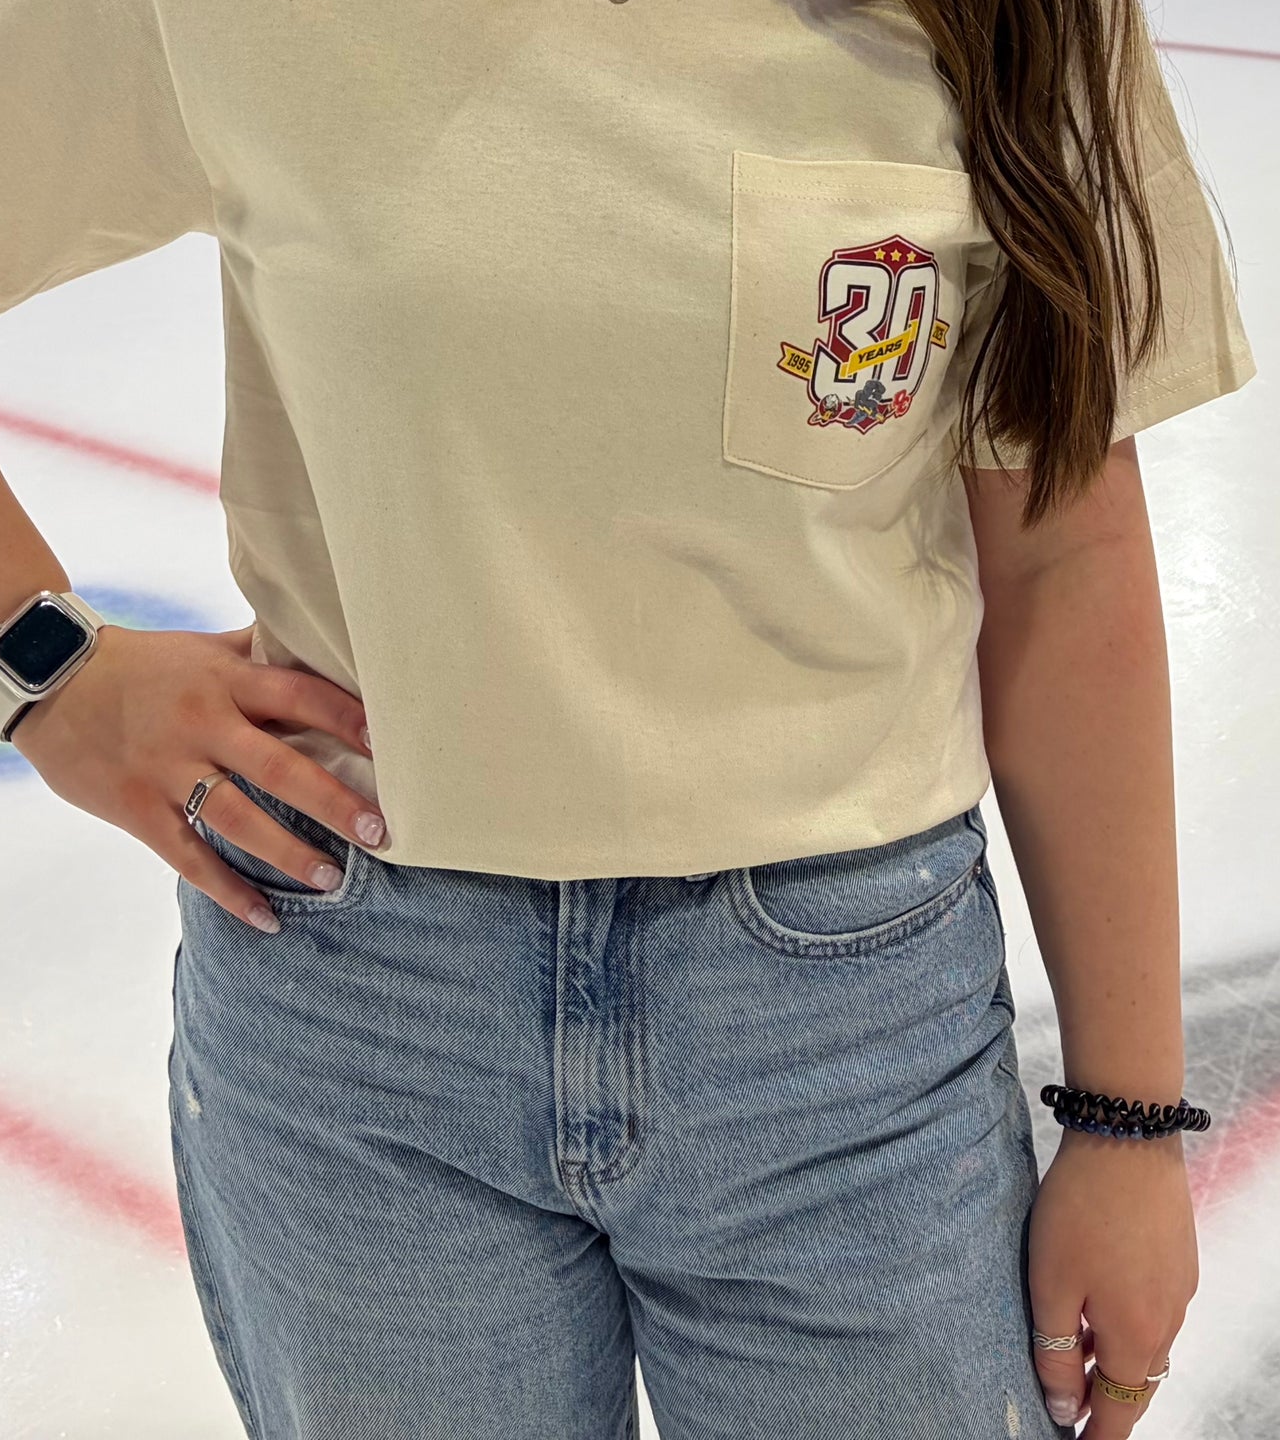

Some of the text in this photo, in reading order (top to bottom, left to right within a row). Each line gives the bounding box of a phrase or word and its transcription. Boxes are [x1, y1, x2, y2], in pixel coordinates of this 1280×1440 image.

[810, 260, 939, 406] 30
[785, 351, 813, 374] 1995
[856, 338, 903, 366] YEARS
